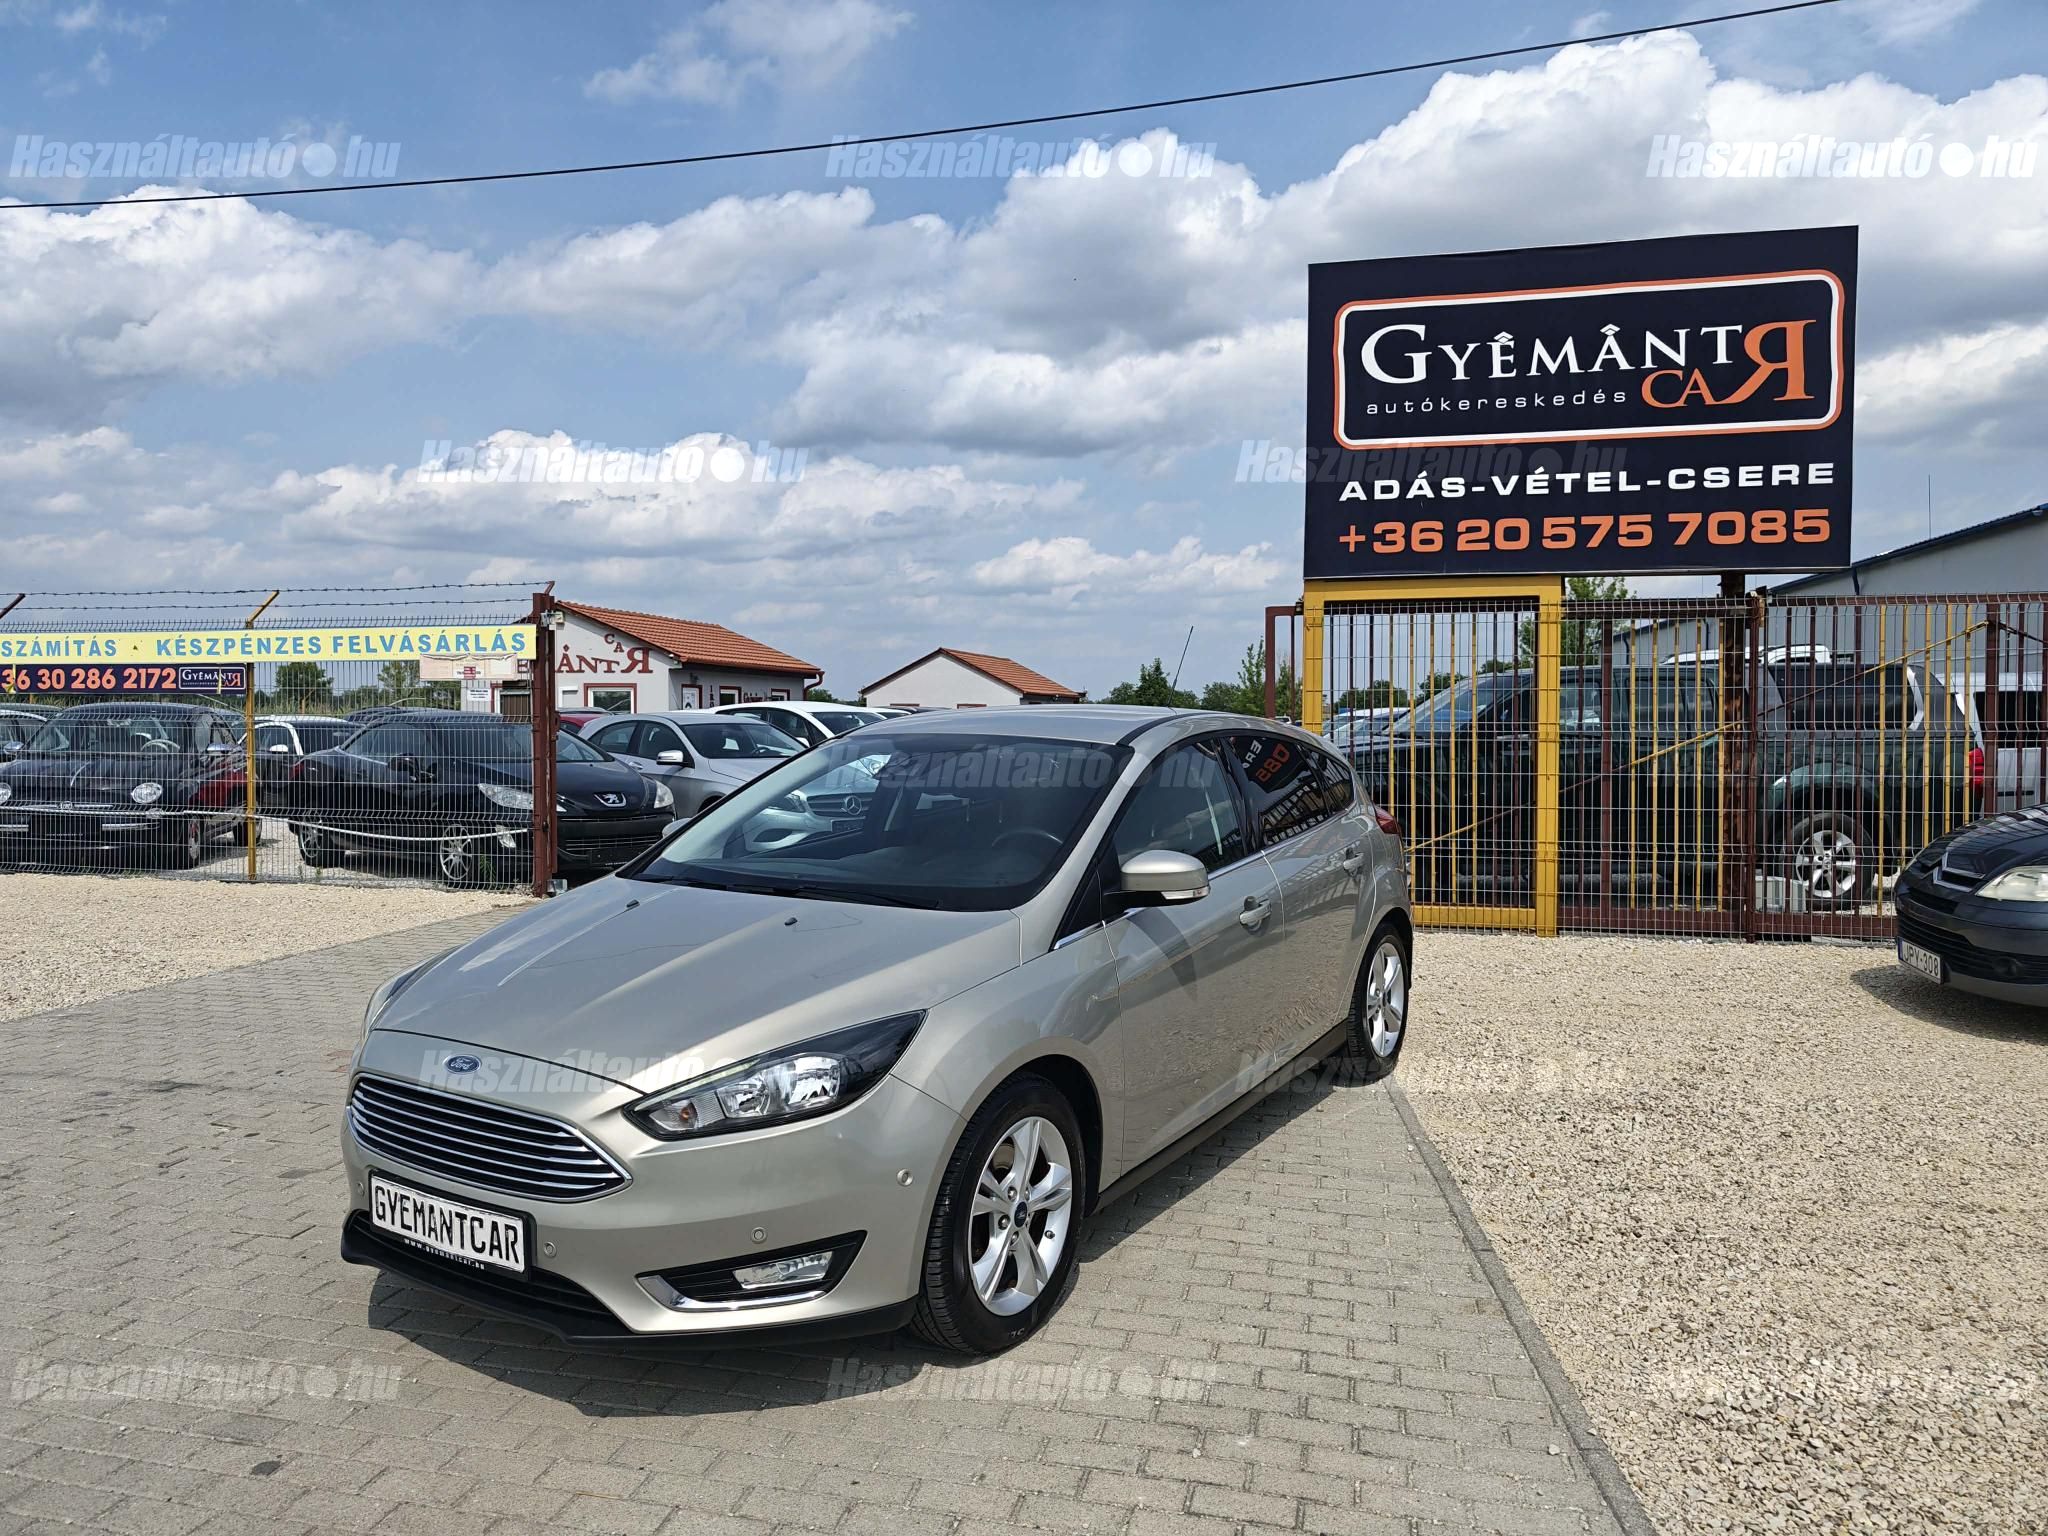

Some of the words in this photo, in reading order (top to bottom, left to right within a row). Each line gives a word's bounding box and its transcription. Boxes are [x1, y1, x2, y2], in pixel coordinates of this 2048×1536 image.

[1366, 388, 1626, 415] autókereskedés
[1338, 462, 1835, 502] ADÁS-VÉTEL-CSERE
[1339, 520, 1443, 554] +36
[1456, 518, 1530, 551] 20
[1541, 514, 1653, 549] 575
[1667, 508, 1831, 546] 7085
[156, 634, 322, 656] KÉSZPÉNZES
[333, 628, 526, 653] FELVÁSÁRLÁS
[37, 668, 65, 690] 30
[71, 668, 116, 690] 286
[123, 668, 177, 689] 2172
[1903, 944, 1939, 977] JPY-308
[450, 1057, 474, 1070] Ford
[374, 1185, 520, 1265] GYEMANTCAR
